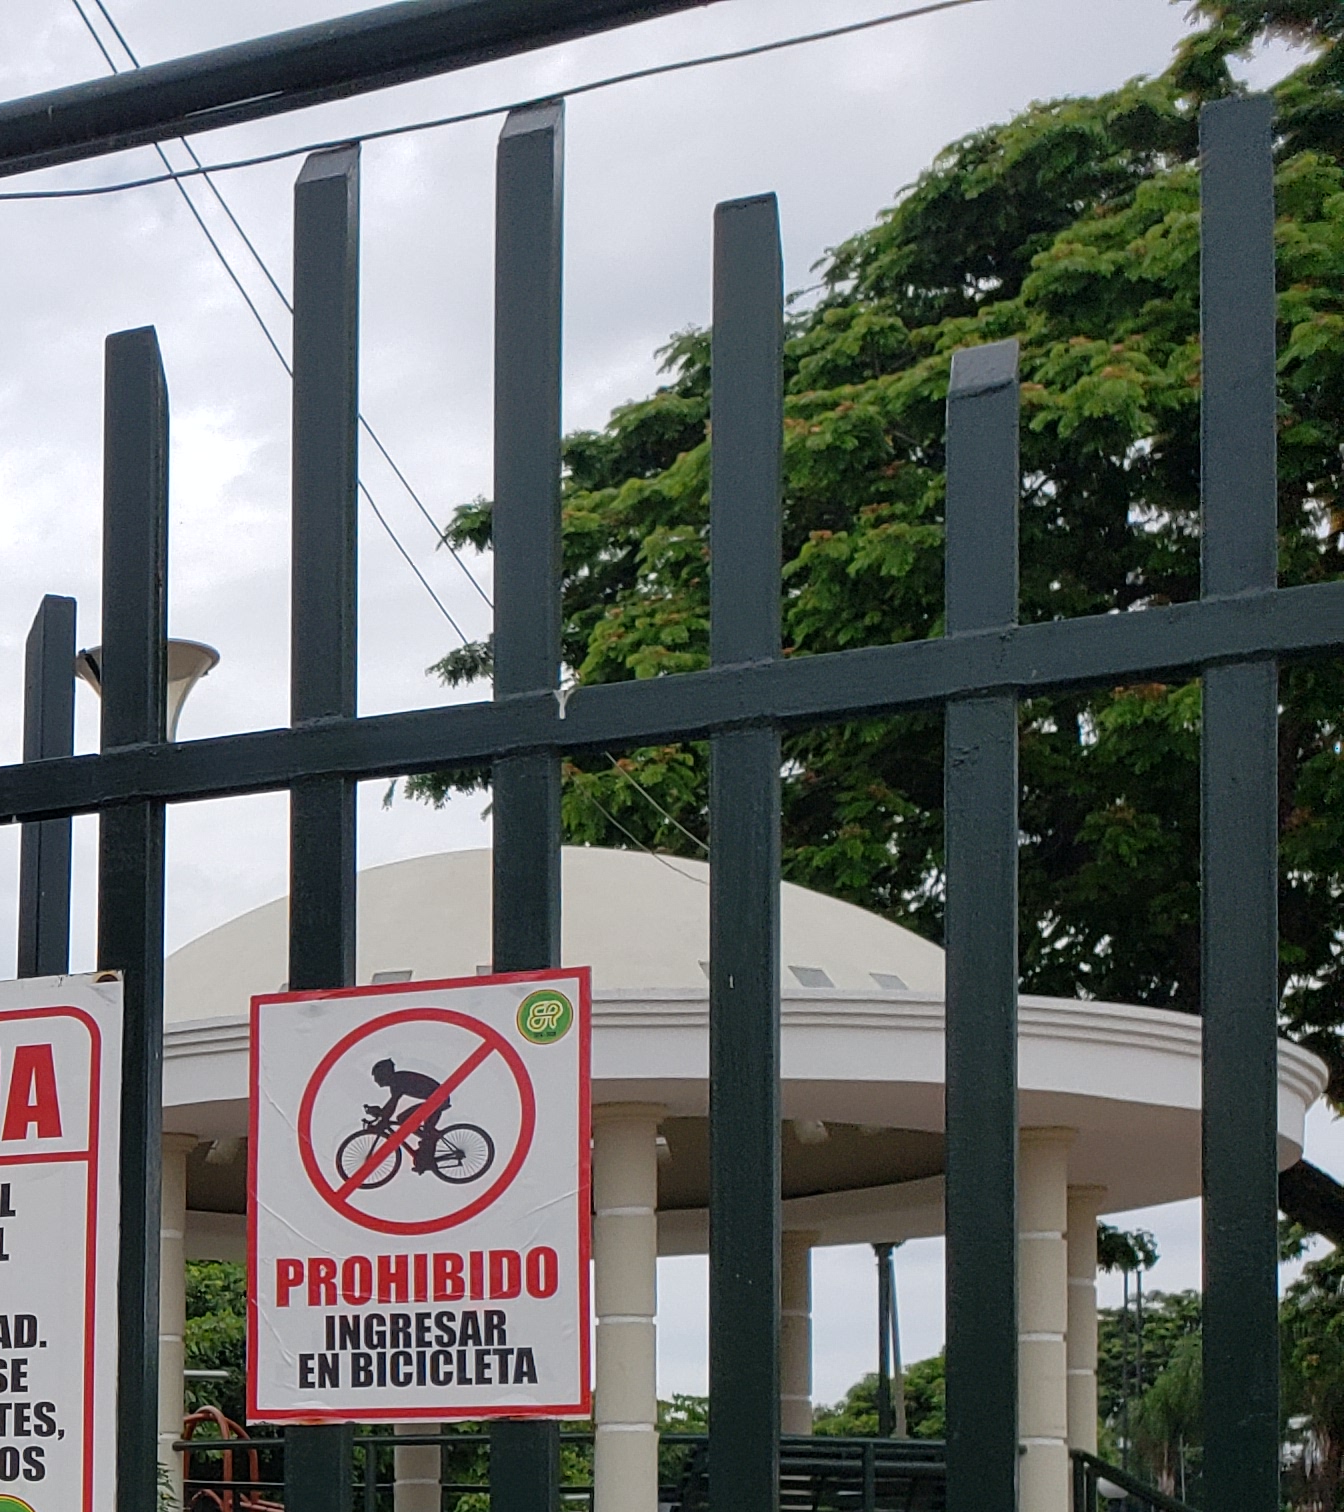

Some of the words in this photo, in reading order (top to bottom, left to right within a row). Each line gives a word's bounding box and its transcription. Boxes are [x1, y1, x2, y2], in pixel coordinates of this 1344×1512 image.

[276, 1246, 558, 1308] PROHIBIDO
[326, 1309, 507, 1351] INGRESAR
[298, 1353, 339, 1389] EN
[351, 1346, 539, 1388] BICICLETA
